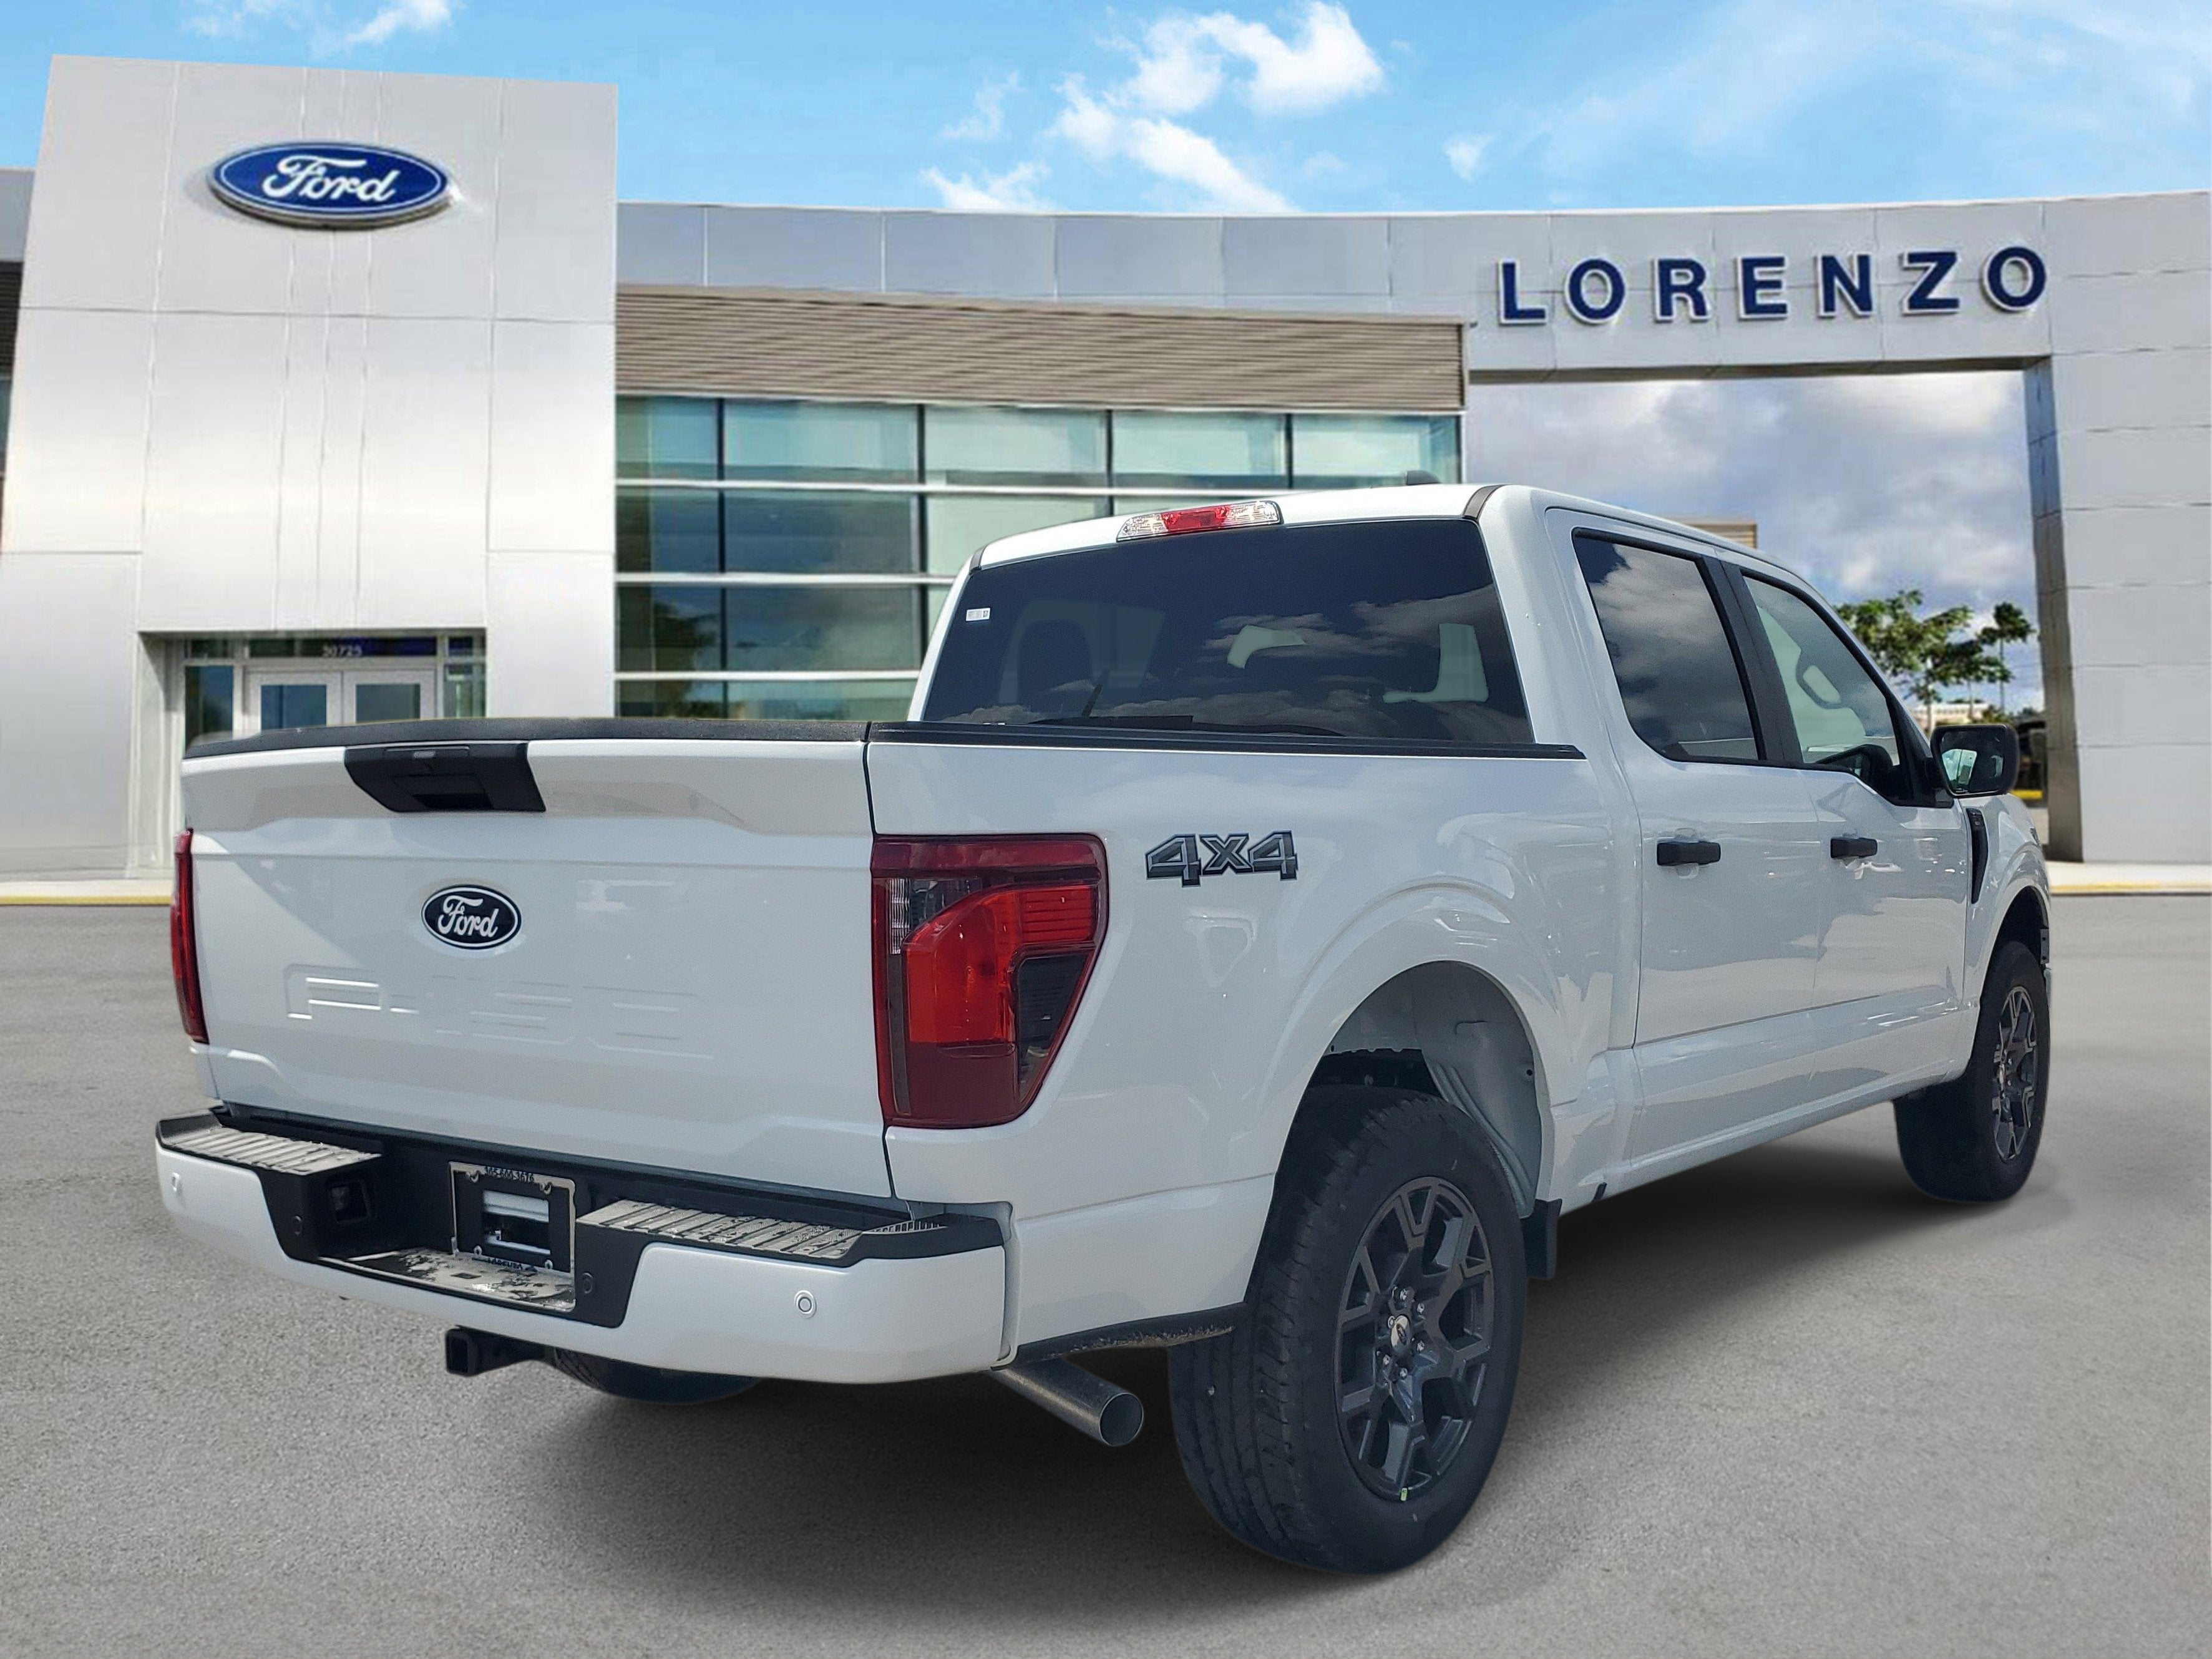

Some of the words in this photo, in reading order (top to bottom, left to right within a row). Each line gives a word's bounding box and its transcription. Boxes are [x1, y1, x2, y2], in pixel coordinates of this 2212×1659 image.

[262, 154, 401, 202] Ford
[1498, 246, 2049, 324] LORENZO
[437, 894, 500, 938] Ford
